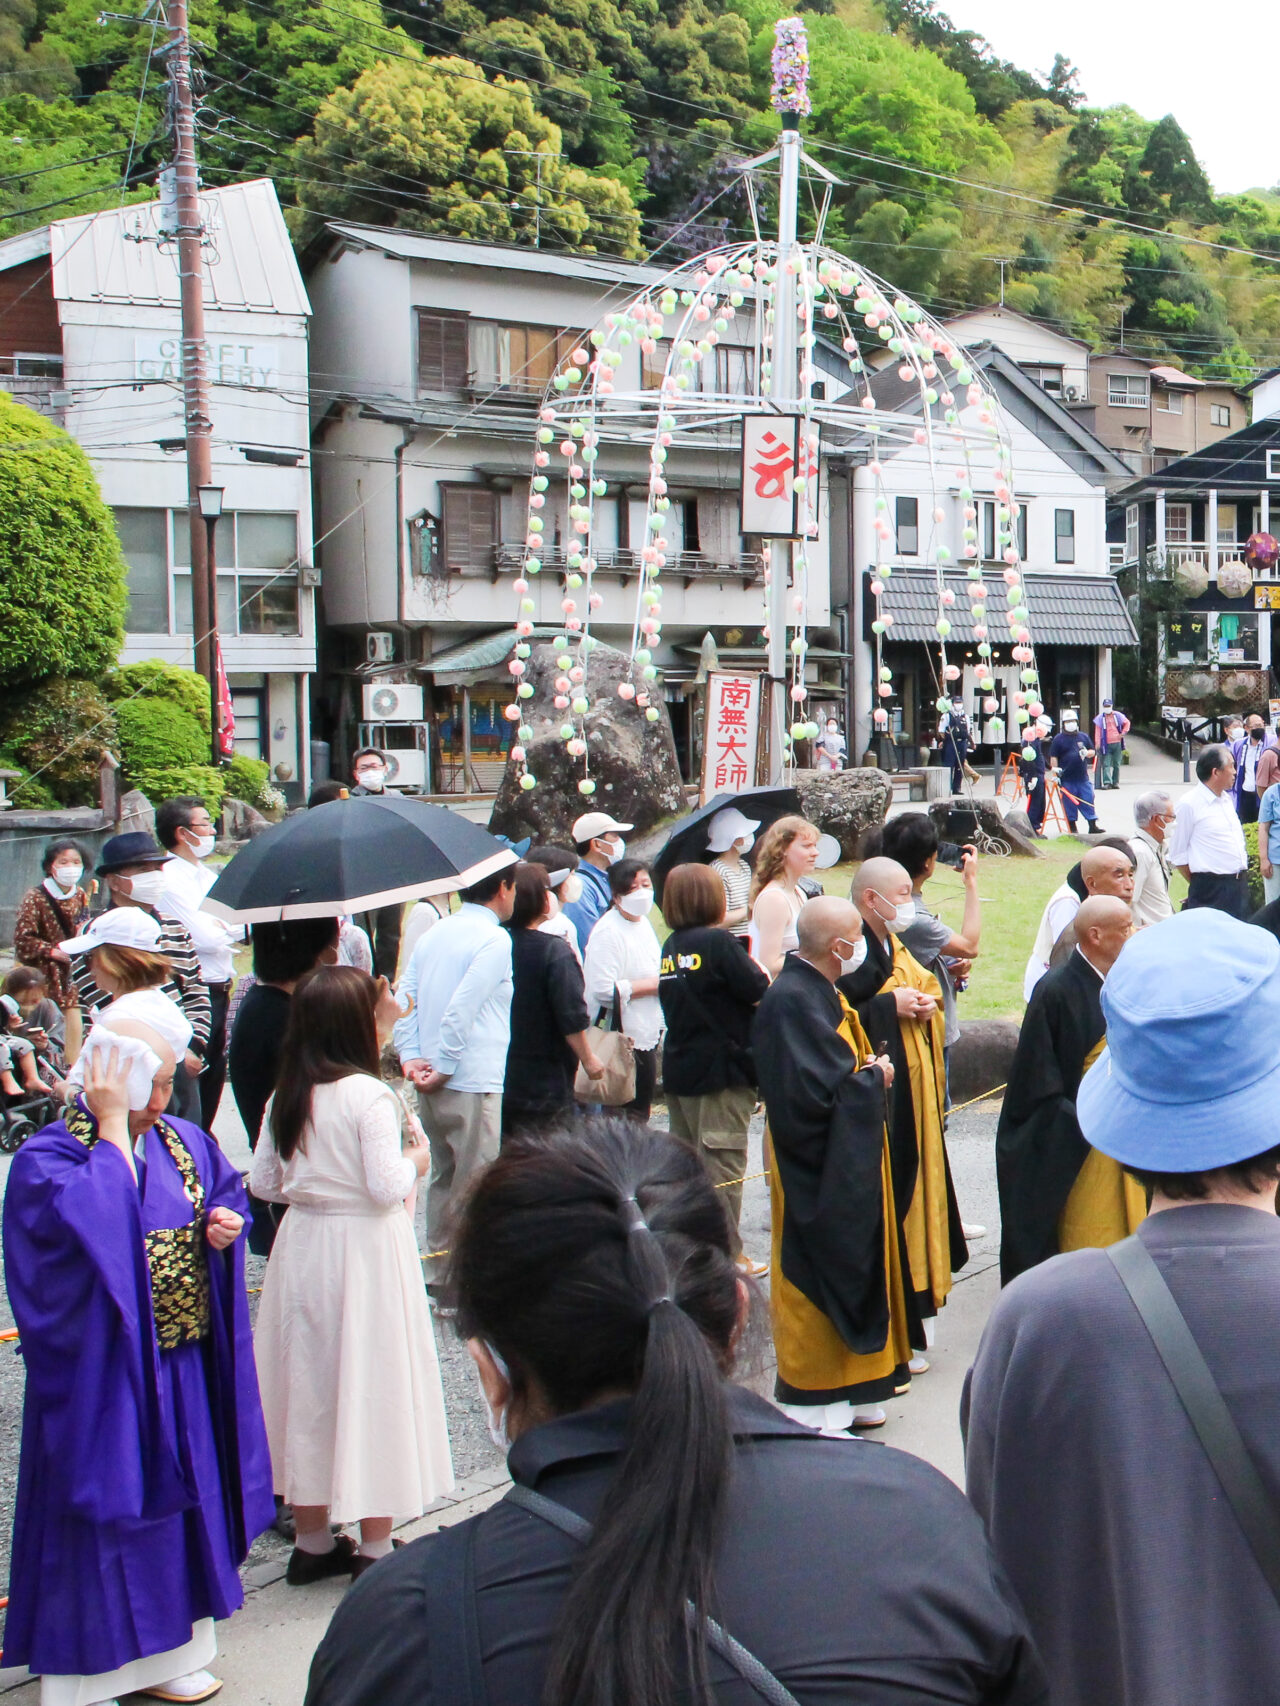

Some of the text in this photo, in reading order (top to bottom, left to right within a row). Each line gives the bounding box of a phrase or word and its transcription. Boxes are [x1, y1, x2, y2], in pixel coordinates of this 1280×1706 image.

[159, 340, 254, 364] CAFT
[139, 360, 272, 385] GAERY
[714, 679, 751, 793] 南無大師
